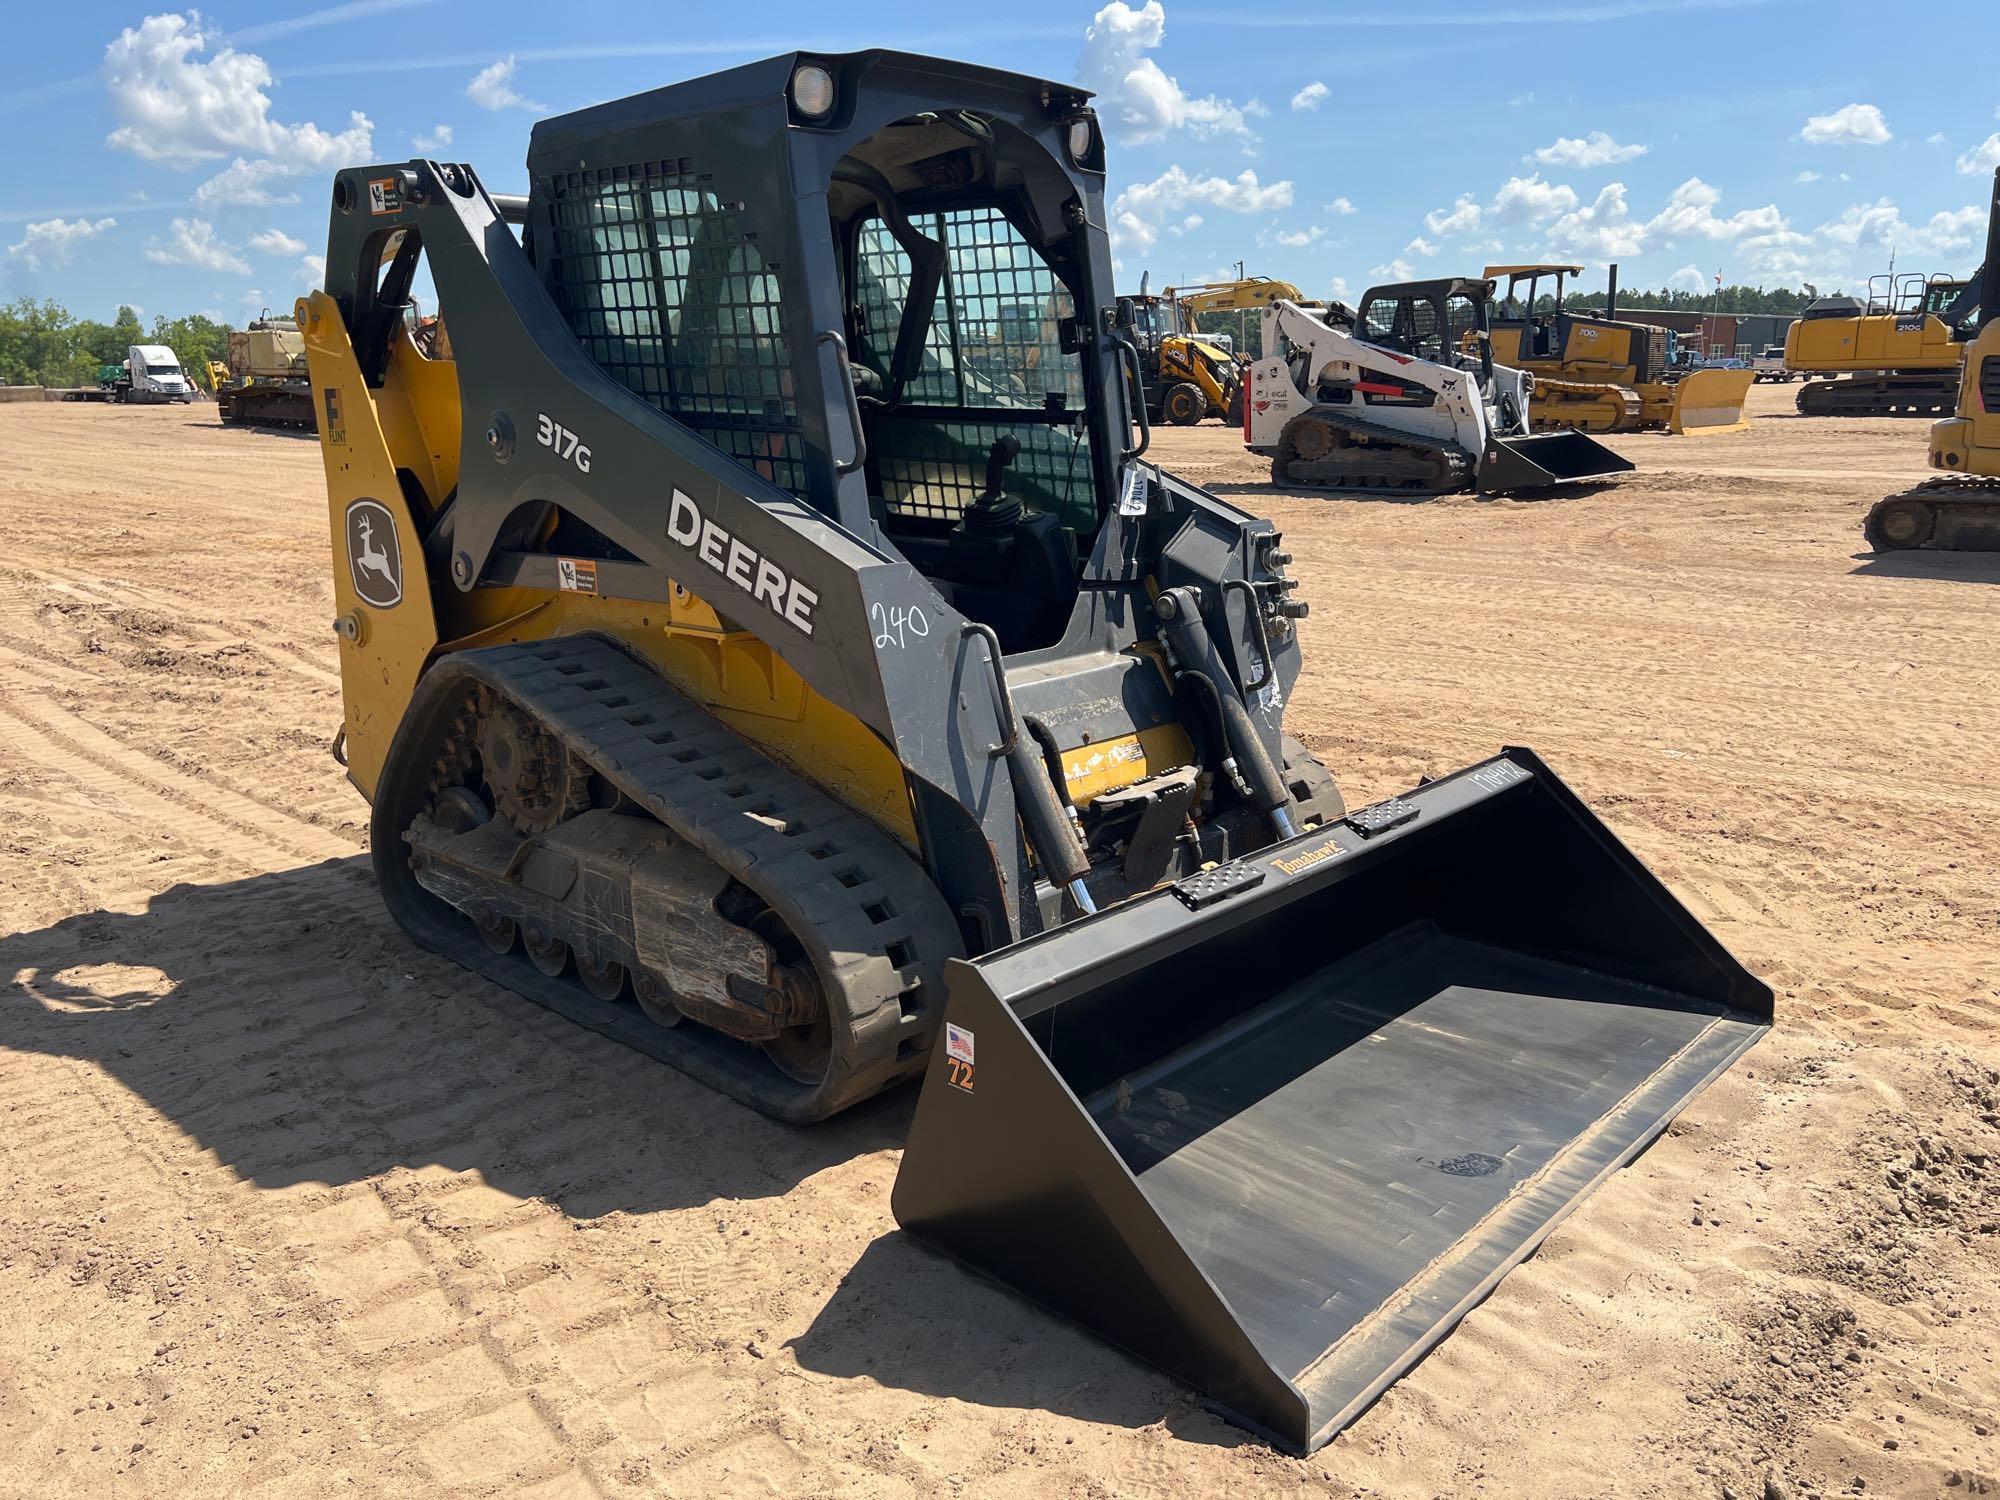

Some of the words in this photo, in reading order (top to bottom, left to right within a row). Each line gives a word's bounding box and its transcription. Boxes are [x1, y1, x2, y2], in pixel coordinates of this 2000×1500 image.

[1167, 348, 1186, 362] JCB
[329, 429, 347, 443] FLINT
[536, 413, 592, 473] 317G
[667, 487, 819, 636] DEERE
[871, 602, 929, 649] 240
[1270, 839, 1344, 876] Tomahawk
